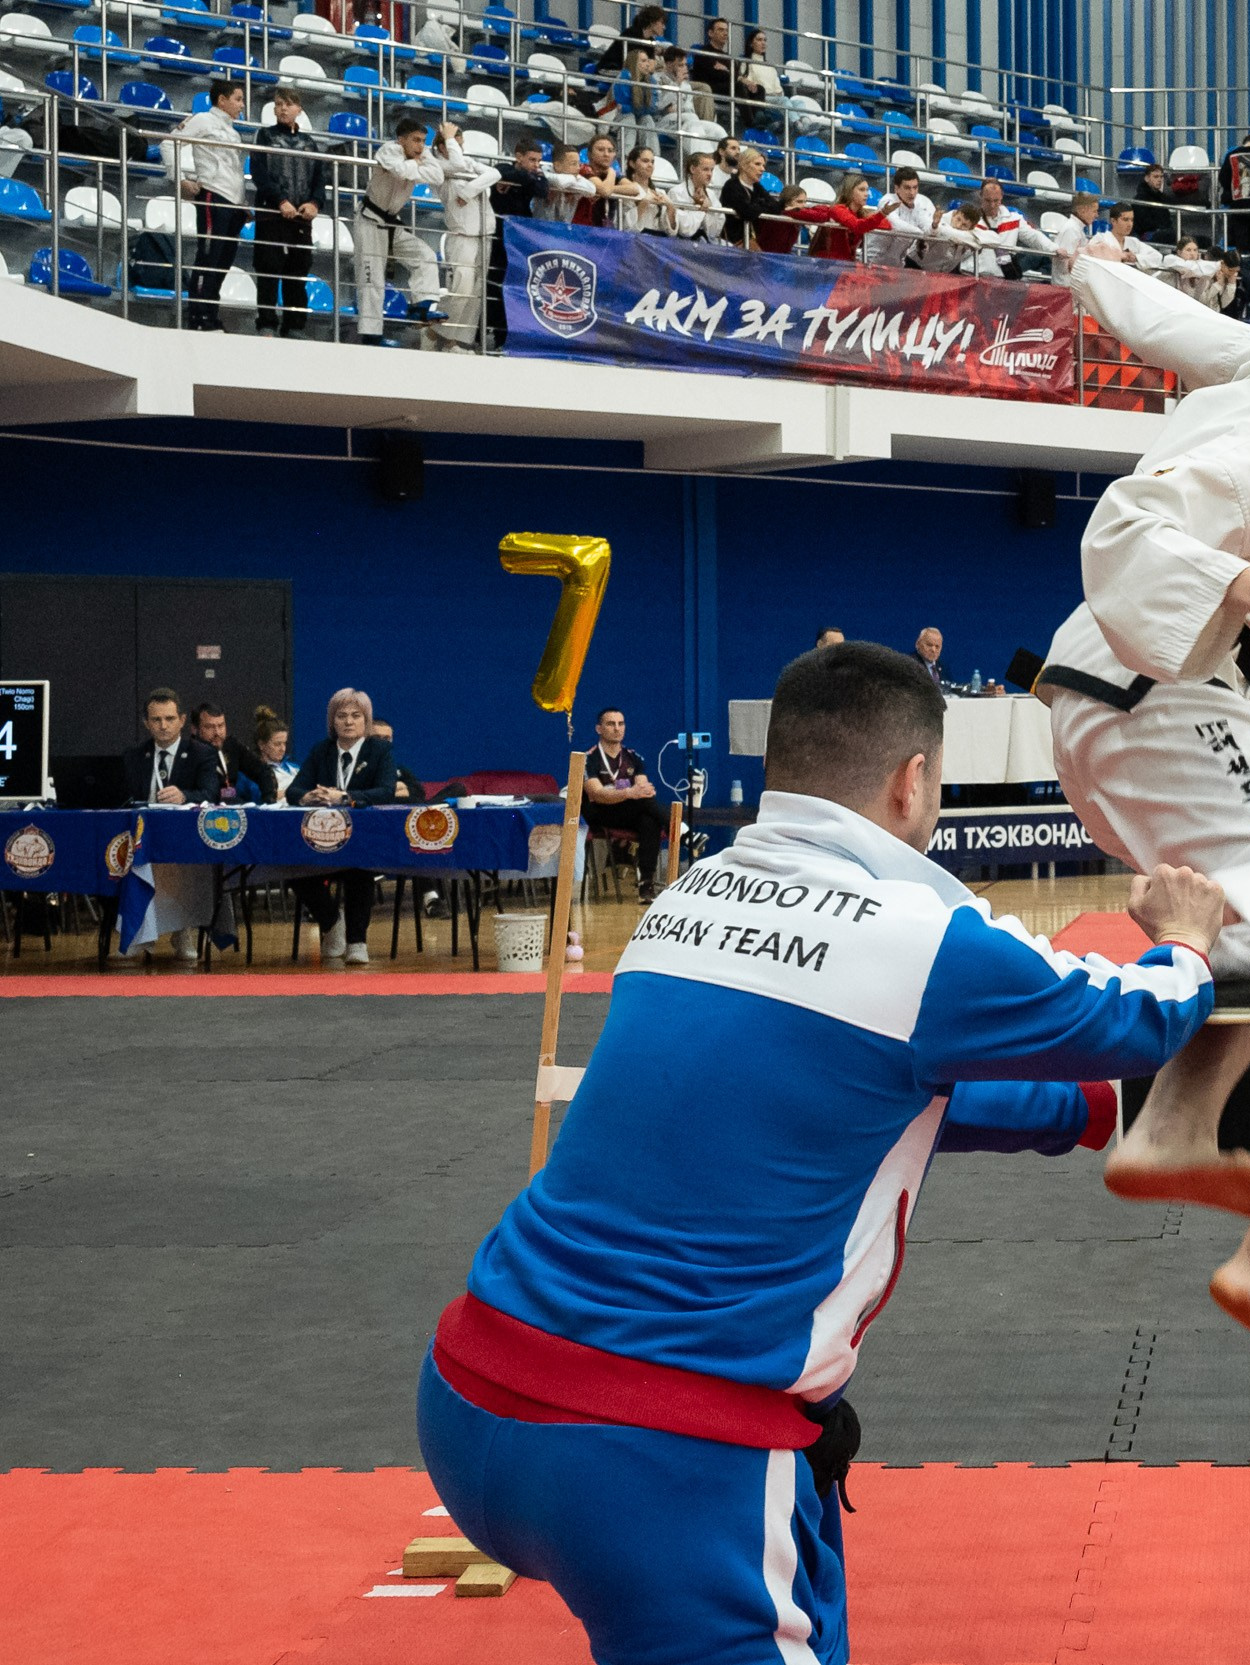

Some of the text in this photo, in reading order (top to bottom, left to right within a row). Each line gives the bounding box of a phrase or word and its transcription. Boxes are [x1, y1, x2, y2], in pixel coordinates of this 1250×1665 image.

[624, 287, 976, 370] АКМ ЗА ТУЛИЦУ!
[924, 828, 957, 854] ИЯ
[667, 867, 882, 923] KWONDO ITF
[718, 924, 830, 973] TEAM
